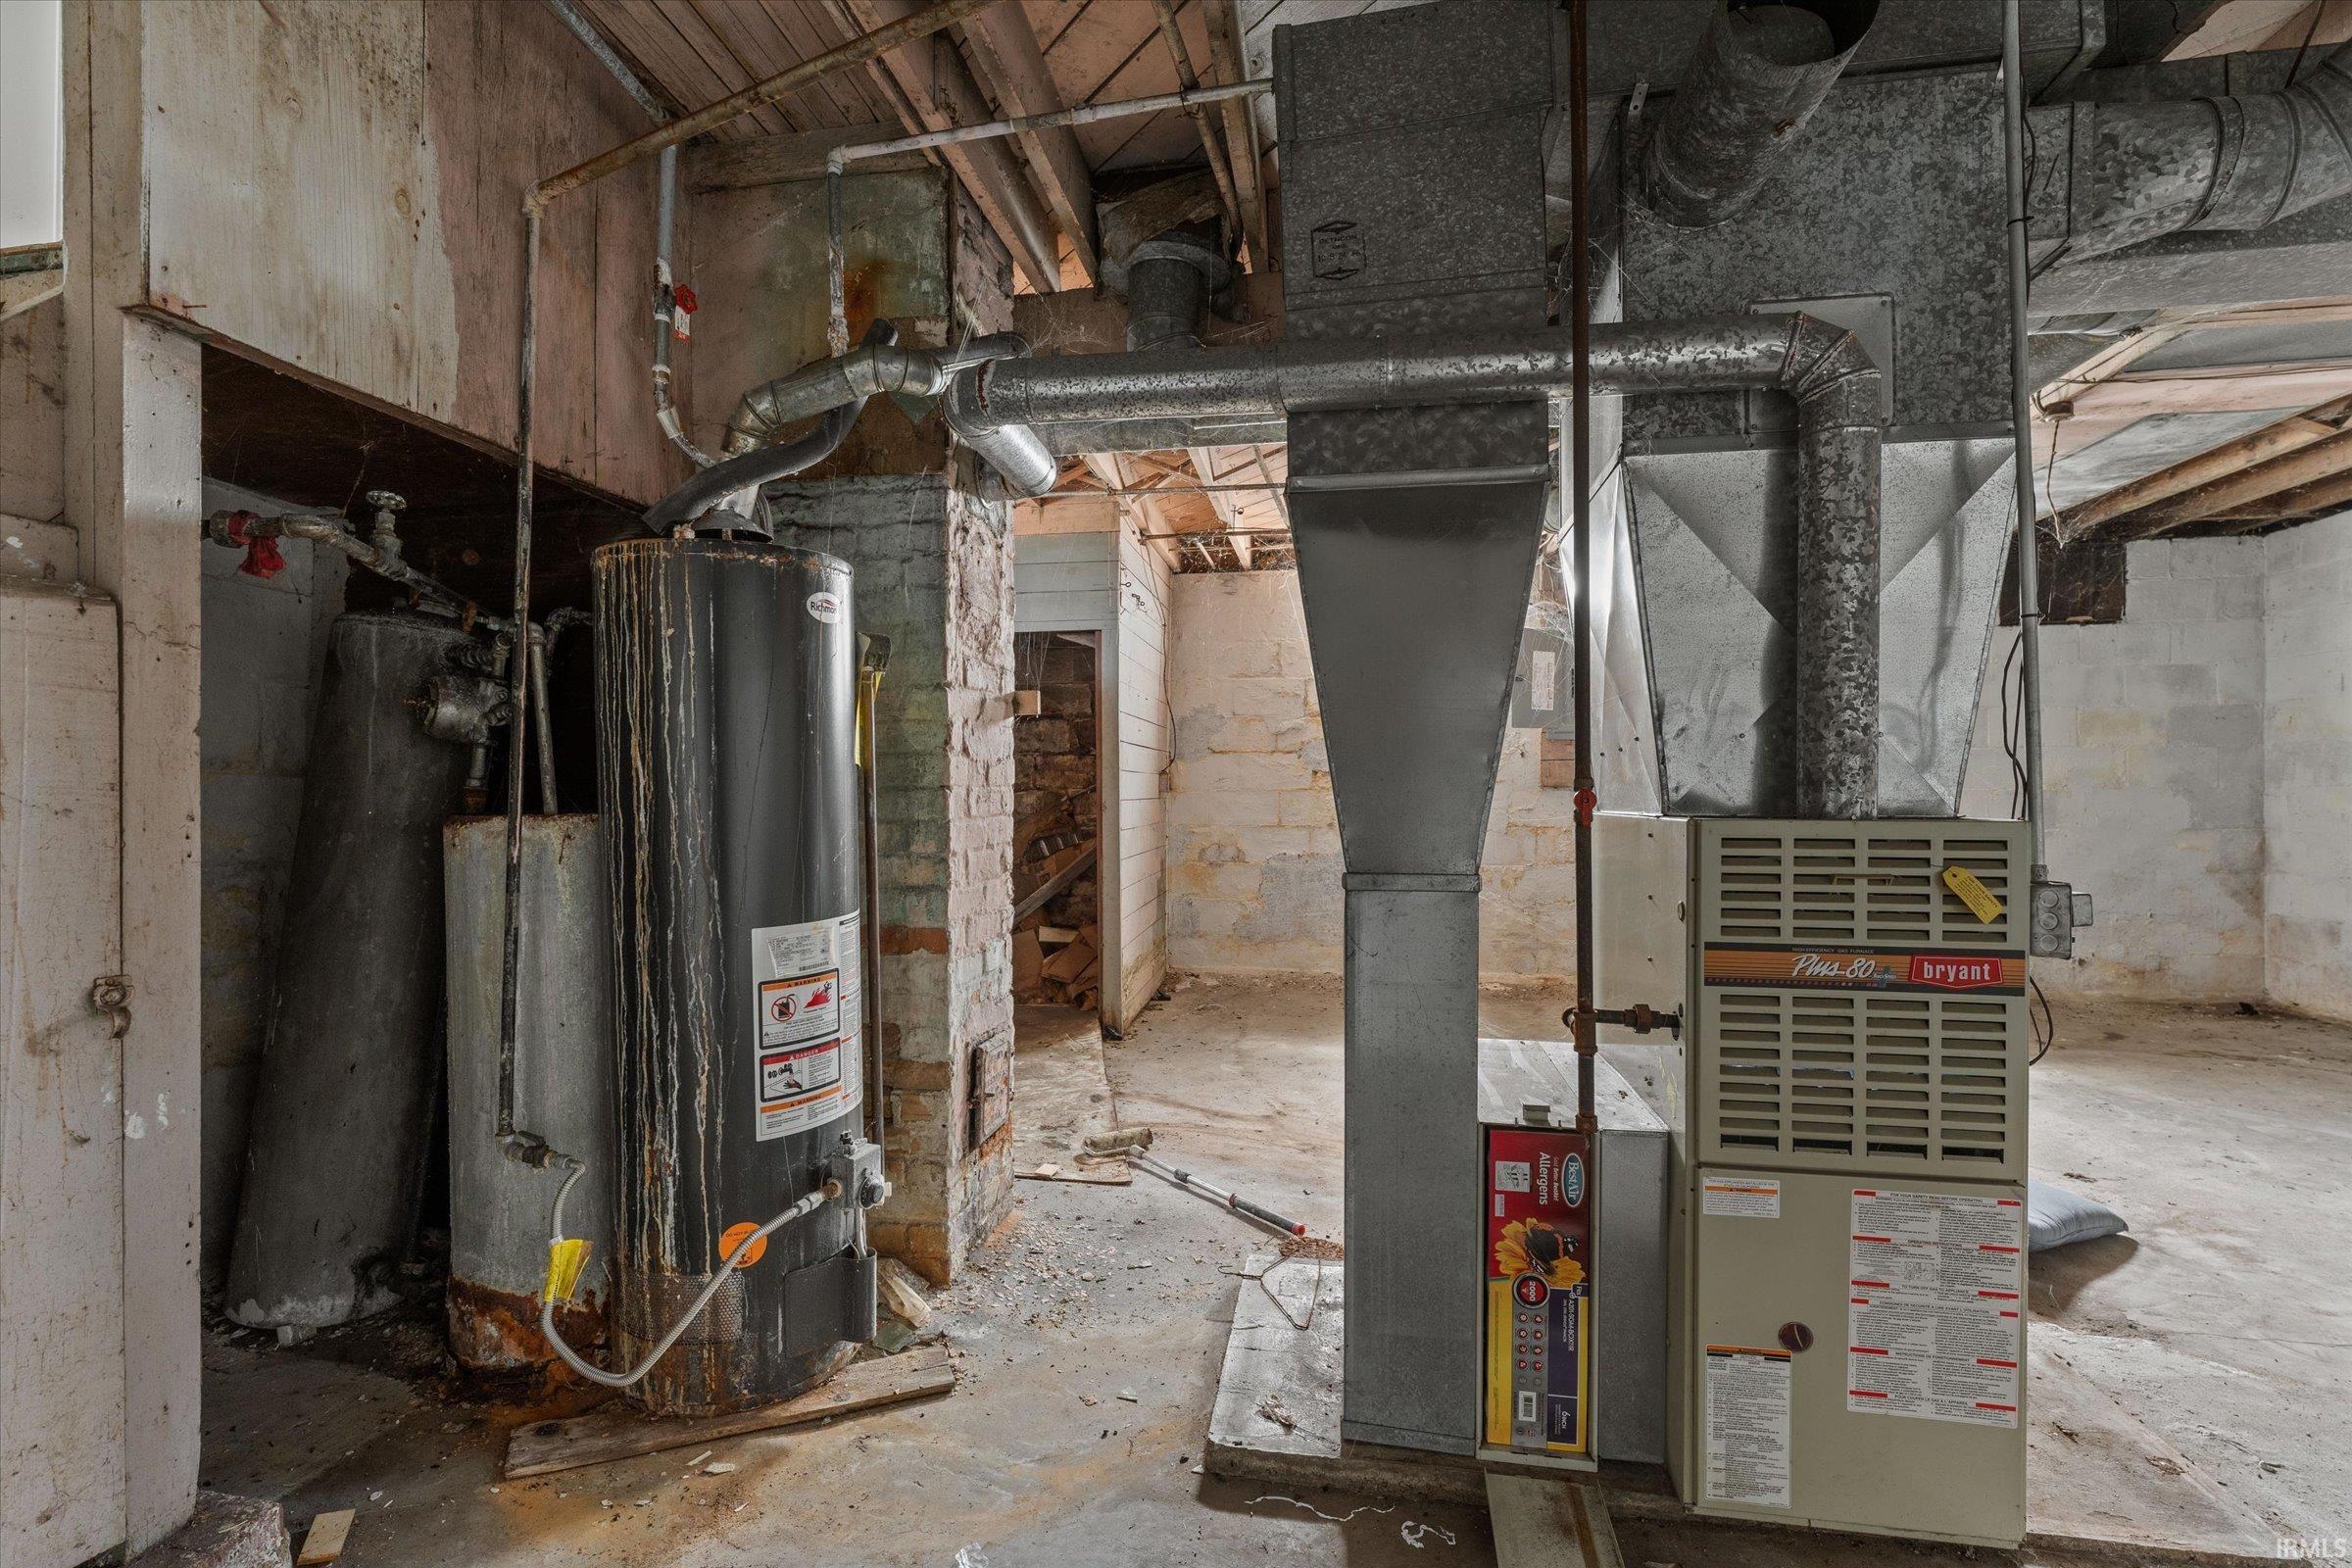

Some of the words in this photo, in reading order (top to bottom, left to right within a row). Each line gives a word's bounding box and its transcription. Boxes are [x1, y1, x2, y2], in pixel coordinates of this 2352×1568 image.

[810, 601, 837, 614] Richmo
[1845, 957, 1876, 978] 80
[1923, 962, 1990, 982] bryant
[795, 977, 821, 986] WARNING
[795, 1050, 819, 1059] DANGER
[797, 1095, 821, 1104] WARNING
[1537, 1152, 1550, 1205] Allergens
[1568, 1161, 1579, 1200] BestAir
